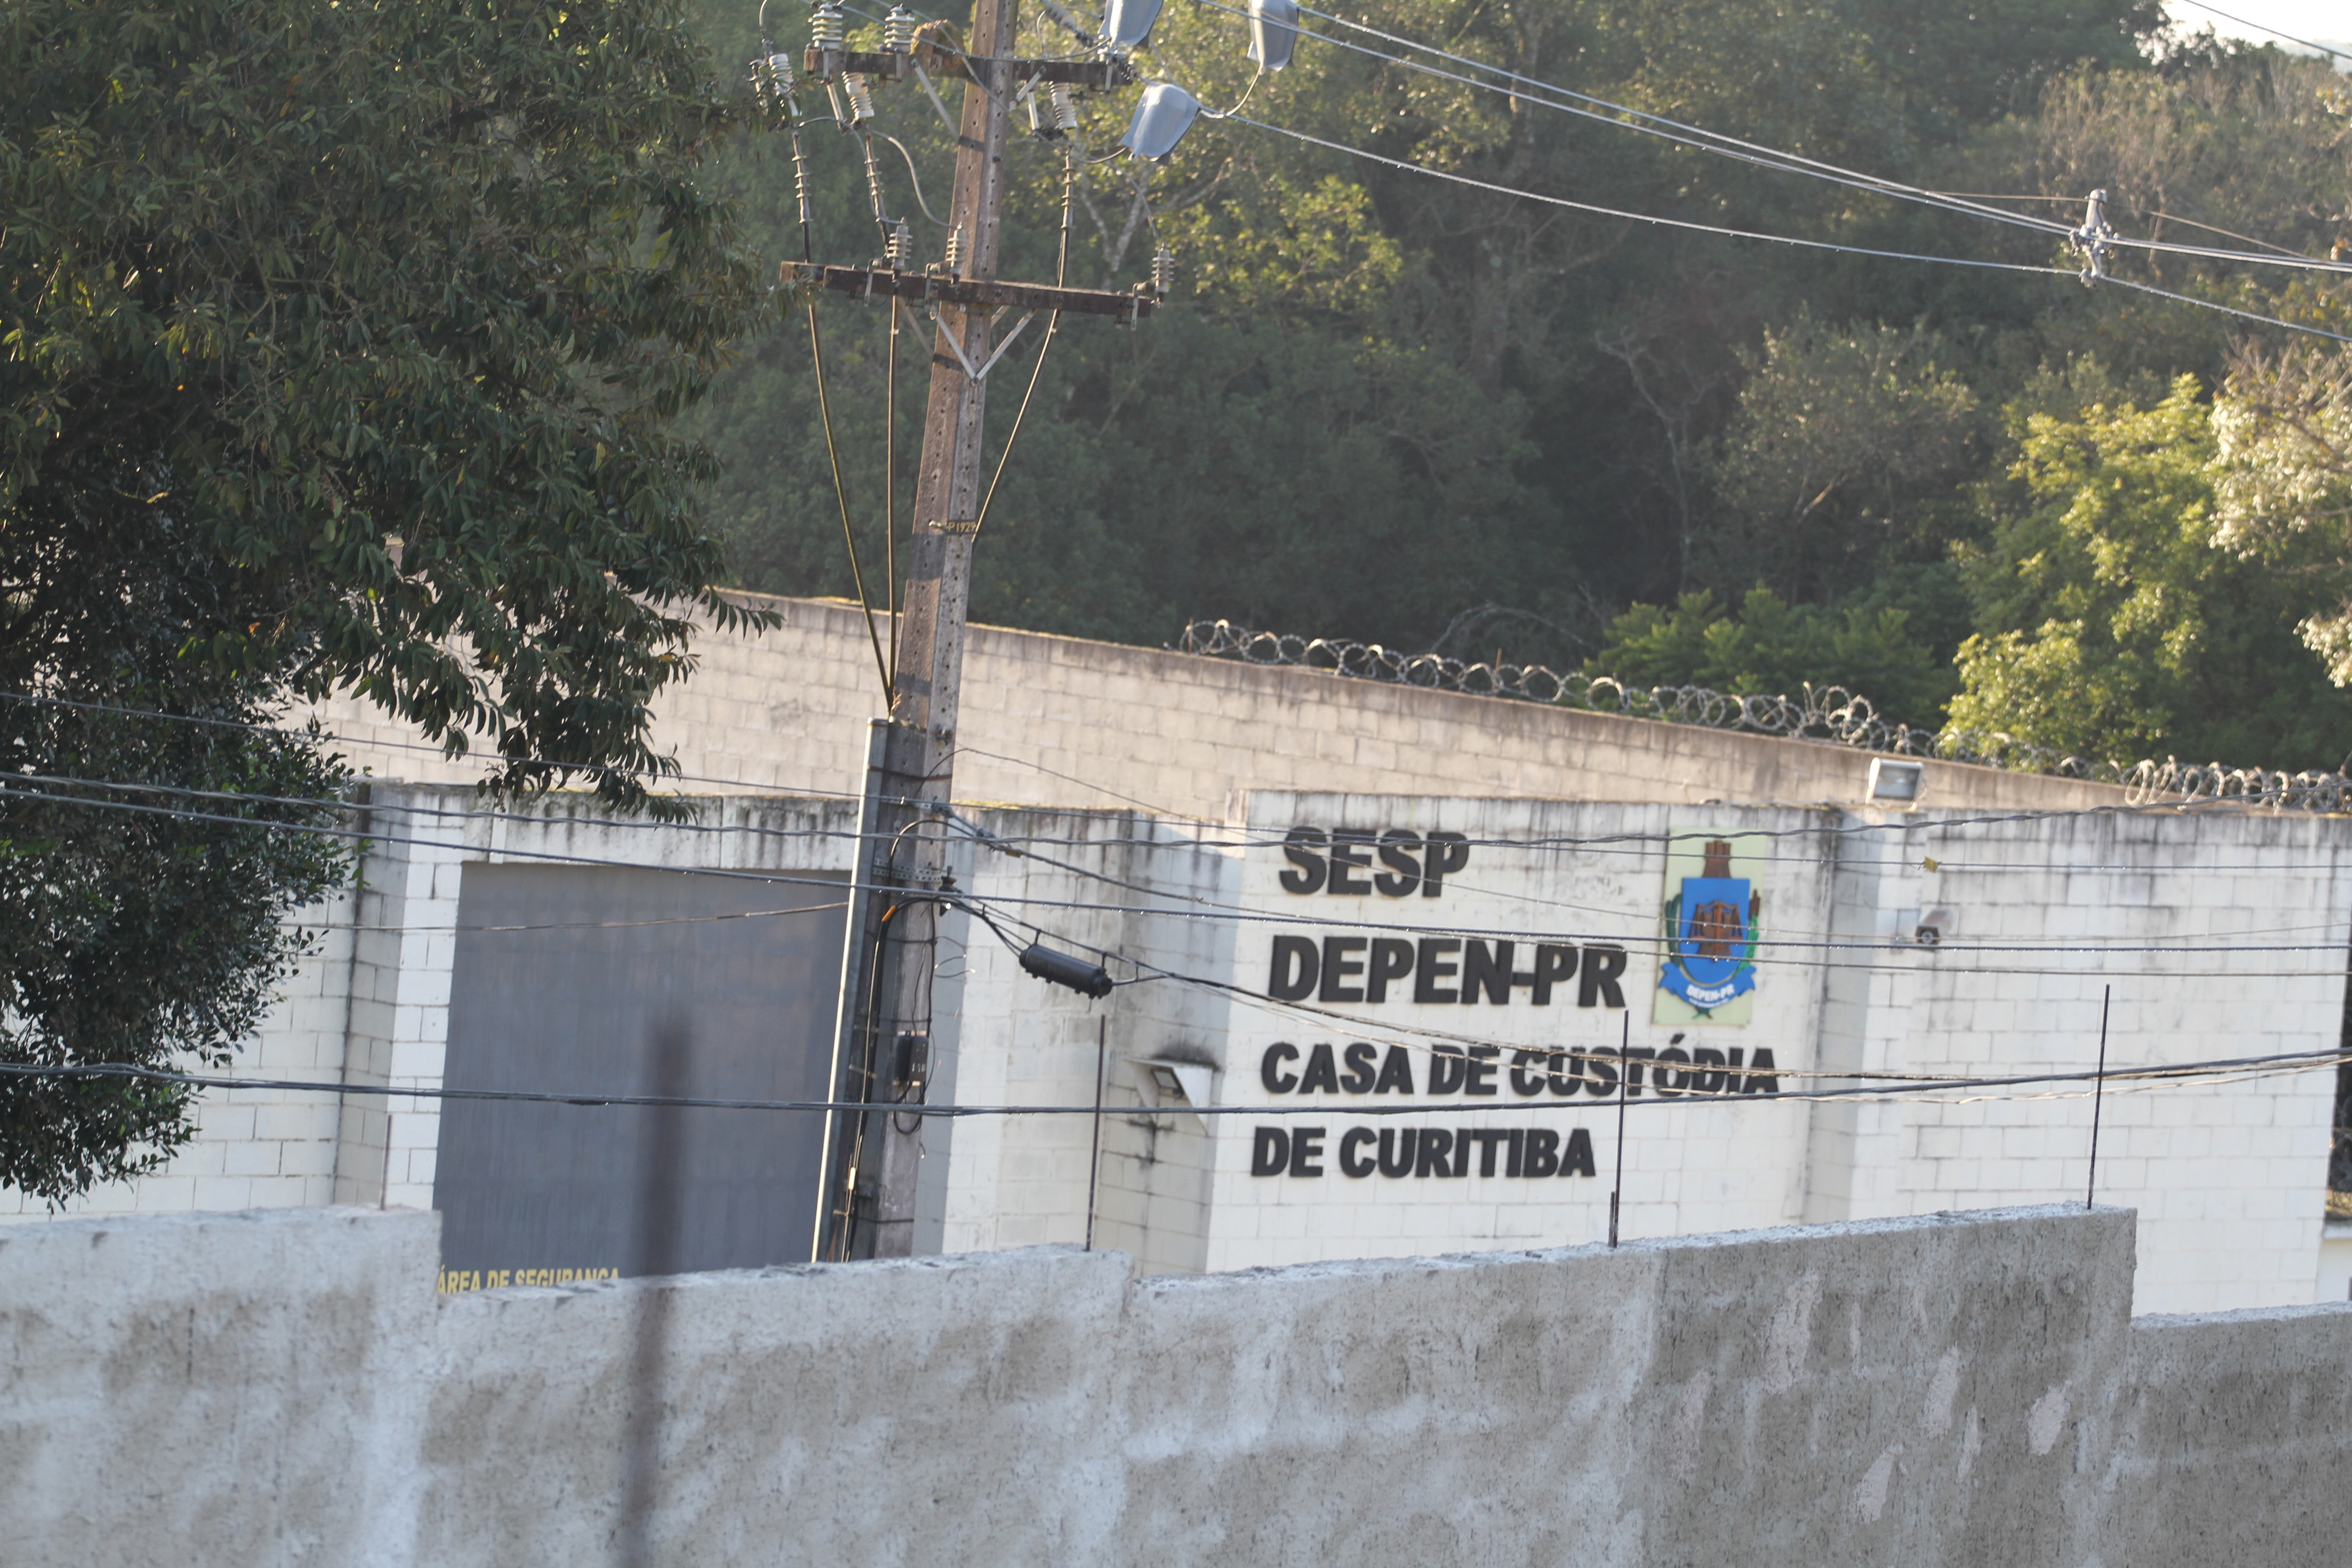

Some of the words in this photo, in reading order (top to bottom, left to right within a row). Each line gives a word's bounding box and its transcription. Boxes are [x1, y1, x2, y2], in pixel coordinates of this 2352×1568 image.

[948, 521, 976, 533] P1929
[1279, 826, 1470, 897] SESP
[1268, 935, 1628, 1008] DEPEN-PR
[1686, 983, 1735, 1002] DEPEN-PR
[1261, 1042, 1414, 1094] CASA
[1428, 1044, 1501, 1095] DE
[1510, 1033, 1779, 1096] CUSTÓDIA
[1251, 1126, 1326, 1177] DE
[1339, 1126, 1596, 1178] CURITIBA
[437, 1264, 481, 1294] ÁREA
[486, 1269, 510, 1289] DE
